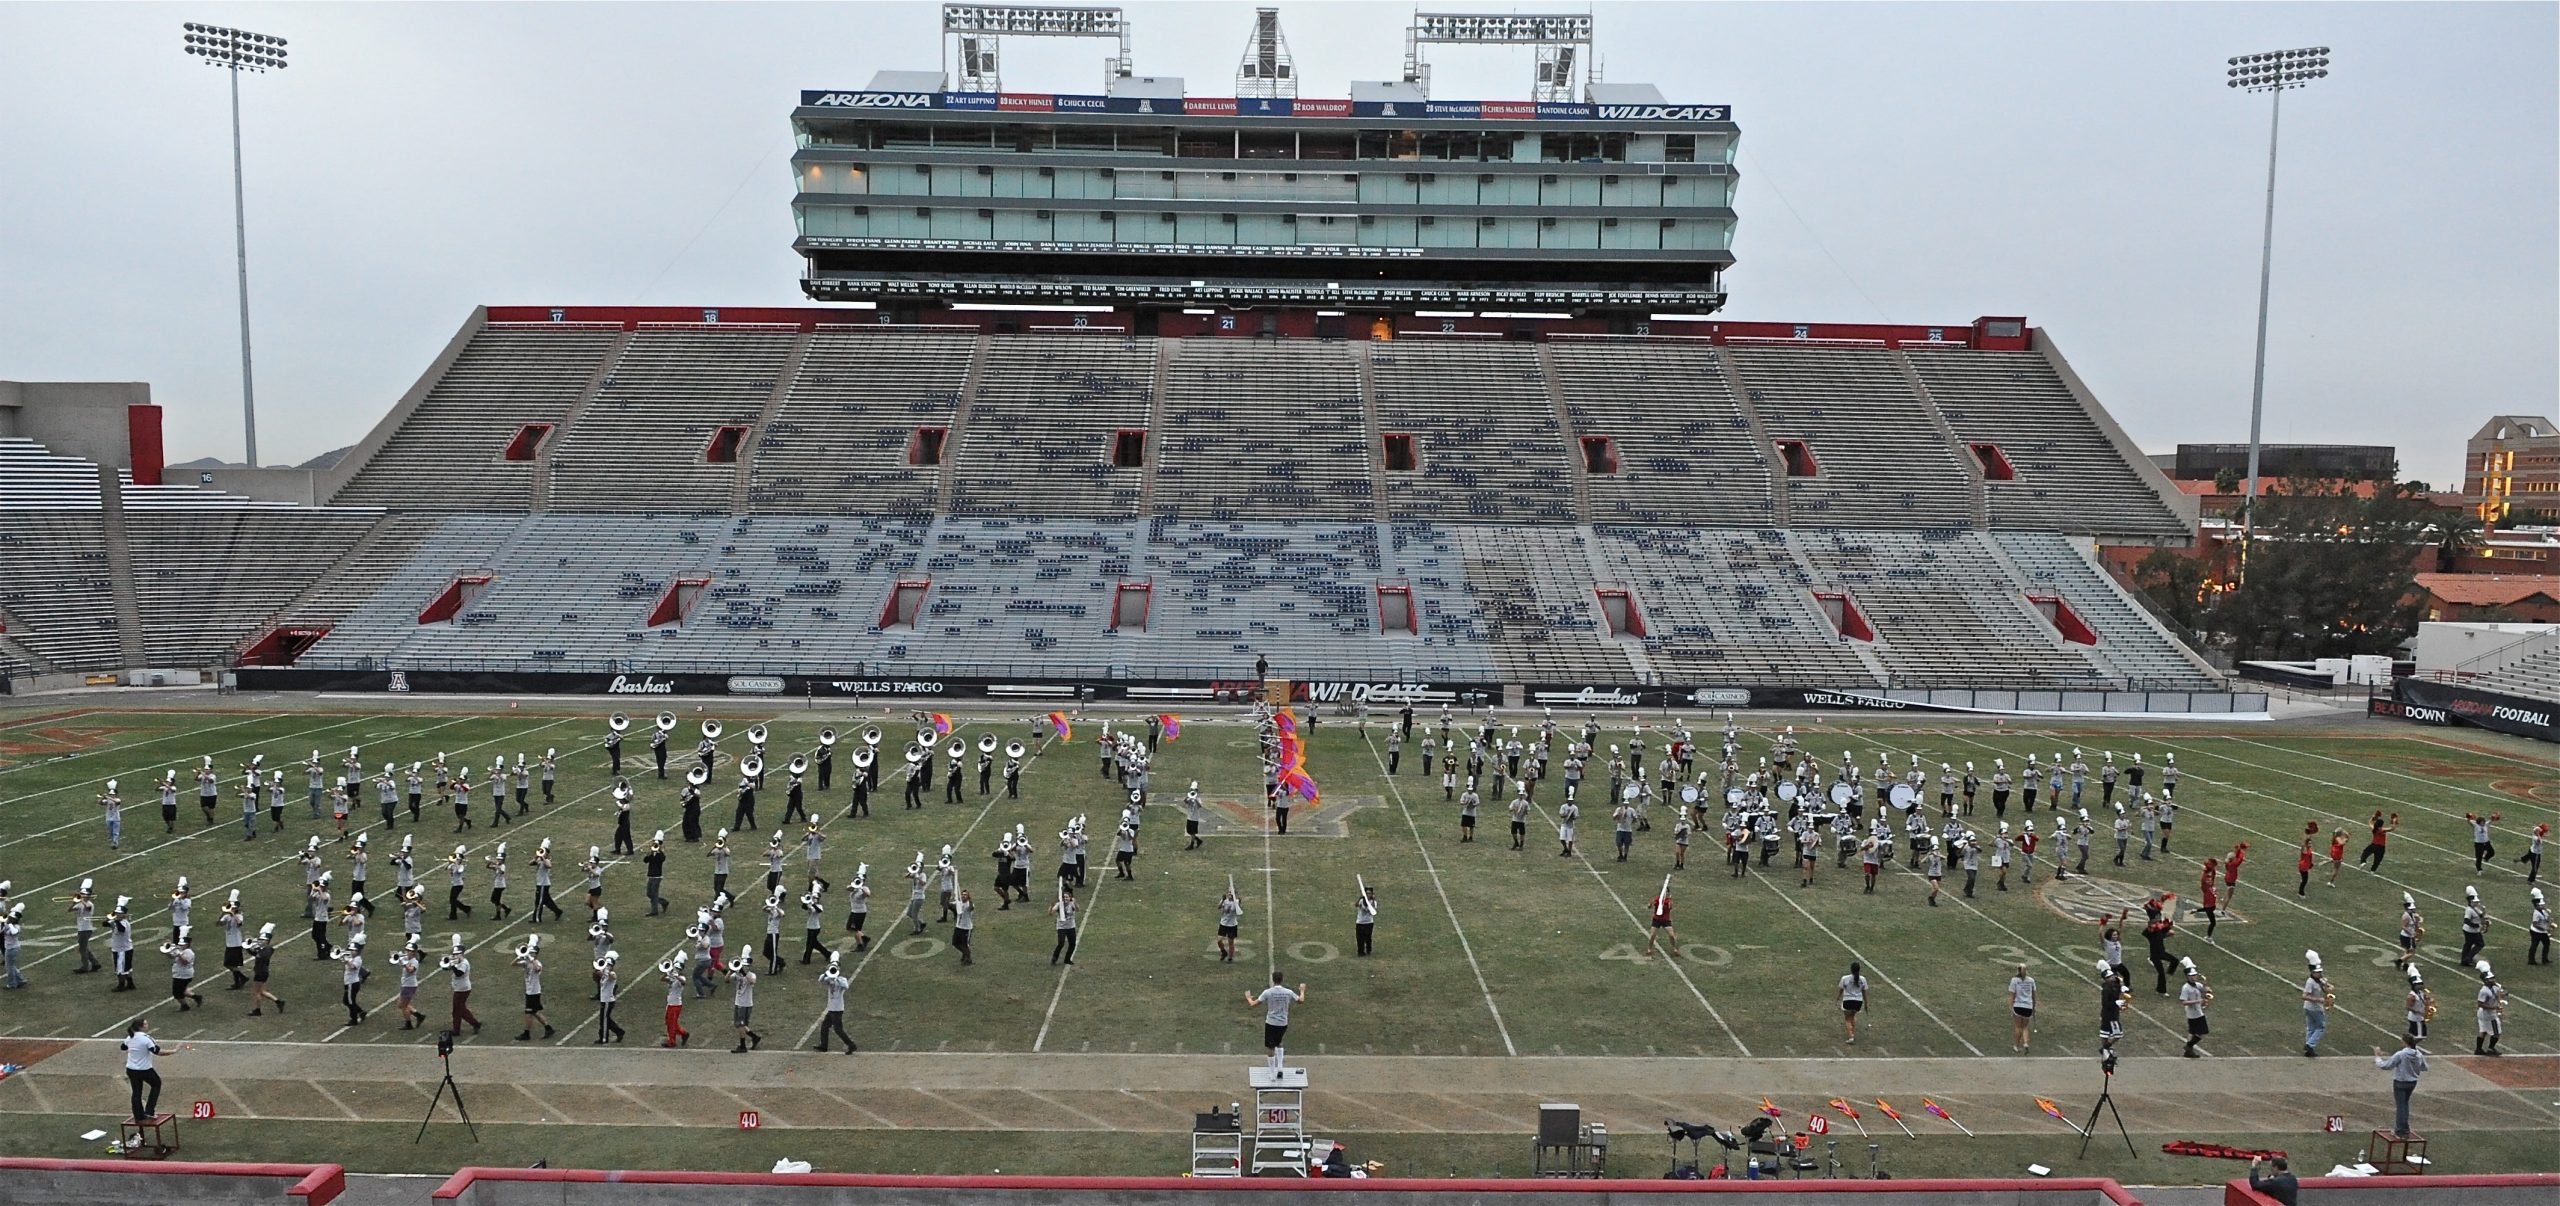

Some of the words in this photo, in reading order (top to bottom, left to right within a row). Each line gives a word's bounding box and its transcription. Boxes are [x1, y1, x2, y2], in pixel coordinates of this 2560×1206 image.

[814, 93, 931, 107] ARIZONA
[946, 96, 954, 105] 22
[954, 96, 967, 105] ART
[968, 97, 995, 105] LUPPINO
[1009, 98, 1027, 106] RICKY
[1028, 98, 1053, 107] HUNLEY
[1063, 99, 1086, 107] CHUCK
[1087, 100, 1105, 108] CECIL
[1183, 101, 1188, 110] 4
[1189, 101, 1217, 110] DARRYLL
[1218, 102, 1236, 110] LEWIS
[1316, 104, 1346, 112] WALDROP
[1434, 105, 1449, 113] STEVE
[1449, 105, 1481, 113] McLAUGHLIN
[1487, 105, 1505, 113] CHRIS
[1506, 105, 1536, 113] McALISTER
[1542, 106, 1568, 114] ANTOINE
[1569, 107, 1590, 115] CASON
[1598, 107, 1724, 120] WILDCATS
[551, 313, 563, 322] 17
[704, 314, 716, 323] 18
[879, 316, 890, 325] 19
[1074, 318, 1087, 327] 20
[1222, 320, 1233, 328] 21
[1442, 324, 1455, 332] 22
[1637, 326, 1649, 335] 23
[1795, 330, 1807, 339] 24
[1929, 333, 1942, 341] 25
[202, 473, 212, 482] 16
[388, 671, 410, 692] A
[608, 675, 674, 693] Bashas'
[749, 680, 780, 689] CASINOS
[838, 681, 890, 692] WELLS
[892, 682, 943, 693] FARGO
[1714, 692, 1746, 701] CASINOS
[1803, 693, 1854, 705] WELLS
[2373, 701, 2405, 715] BEAR
[2405, 706, 2446, 722] DOWN
[2492, 705, 2550, 726] FOOTBALL
[194, 1102, 210, 1117] 30
[741, 1113, 757, 1128] 40
[1270, 1109, 1286, 1123] 50
[1810, 1116, 1824, 1133] 40
[2329, 1117, 2343, 1132] 30
